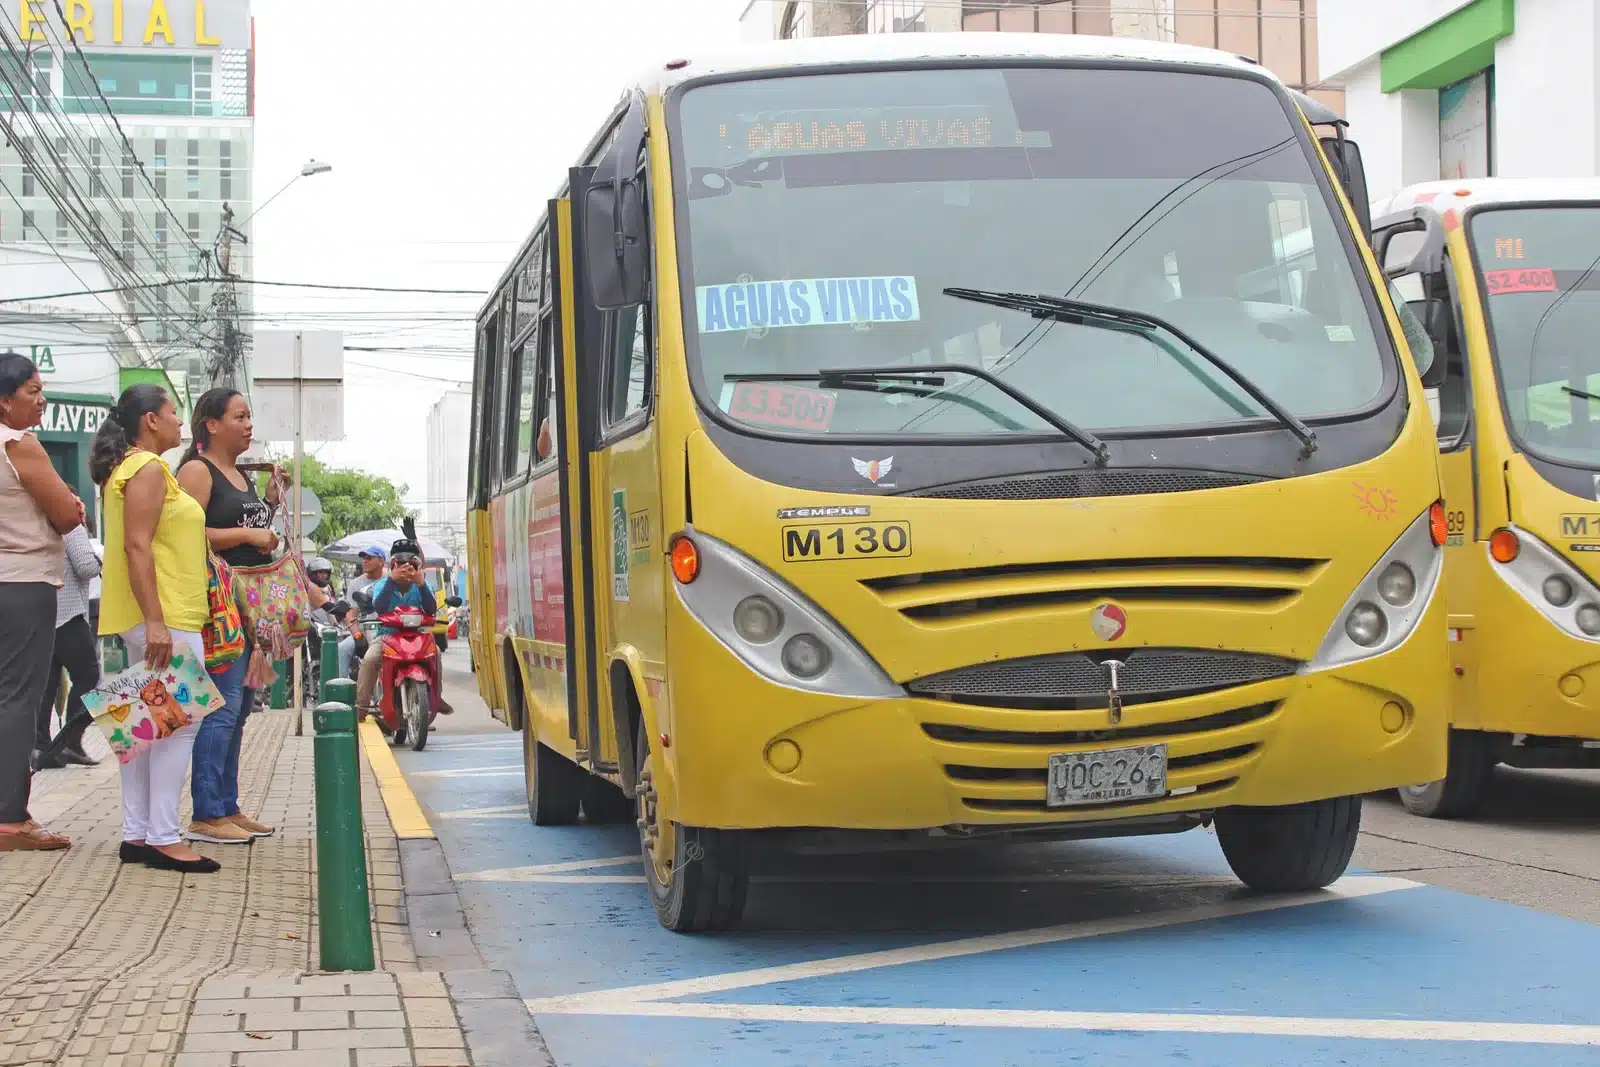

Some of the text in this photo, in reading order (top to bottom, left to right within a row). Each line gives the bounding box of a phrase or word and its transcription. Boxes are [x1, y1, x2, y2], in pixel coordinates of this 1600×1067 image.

[747, 116, 993, 153] AGUAS VIVAS
[705, 277, 913, 332] AGUAS VIVAS
[786, 525, 907, 557] M130
